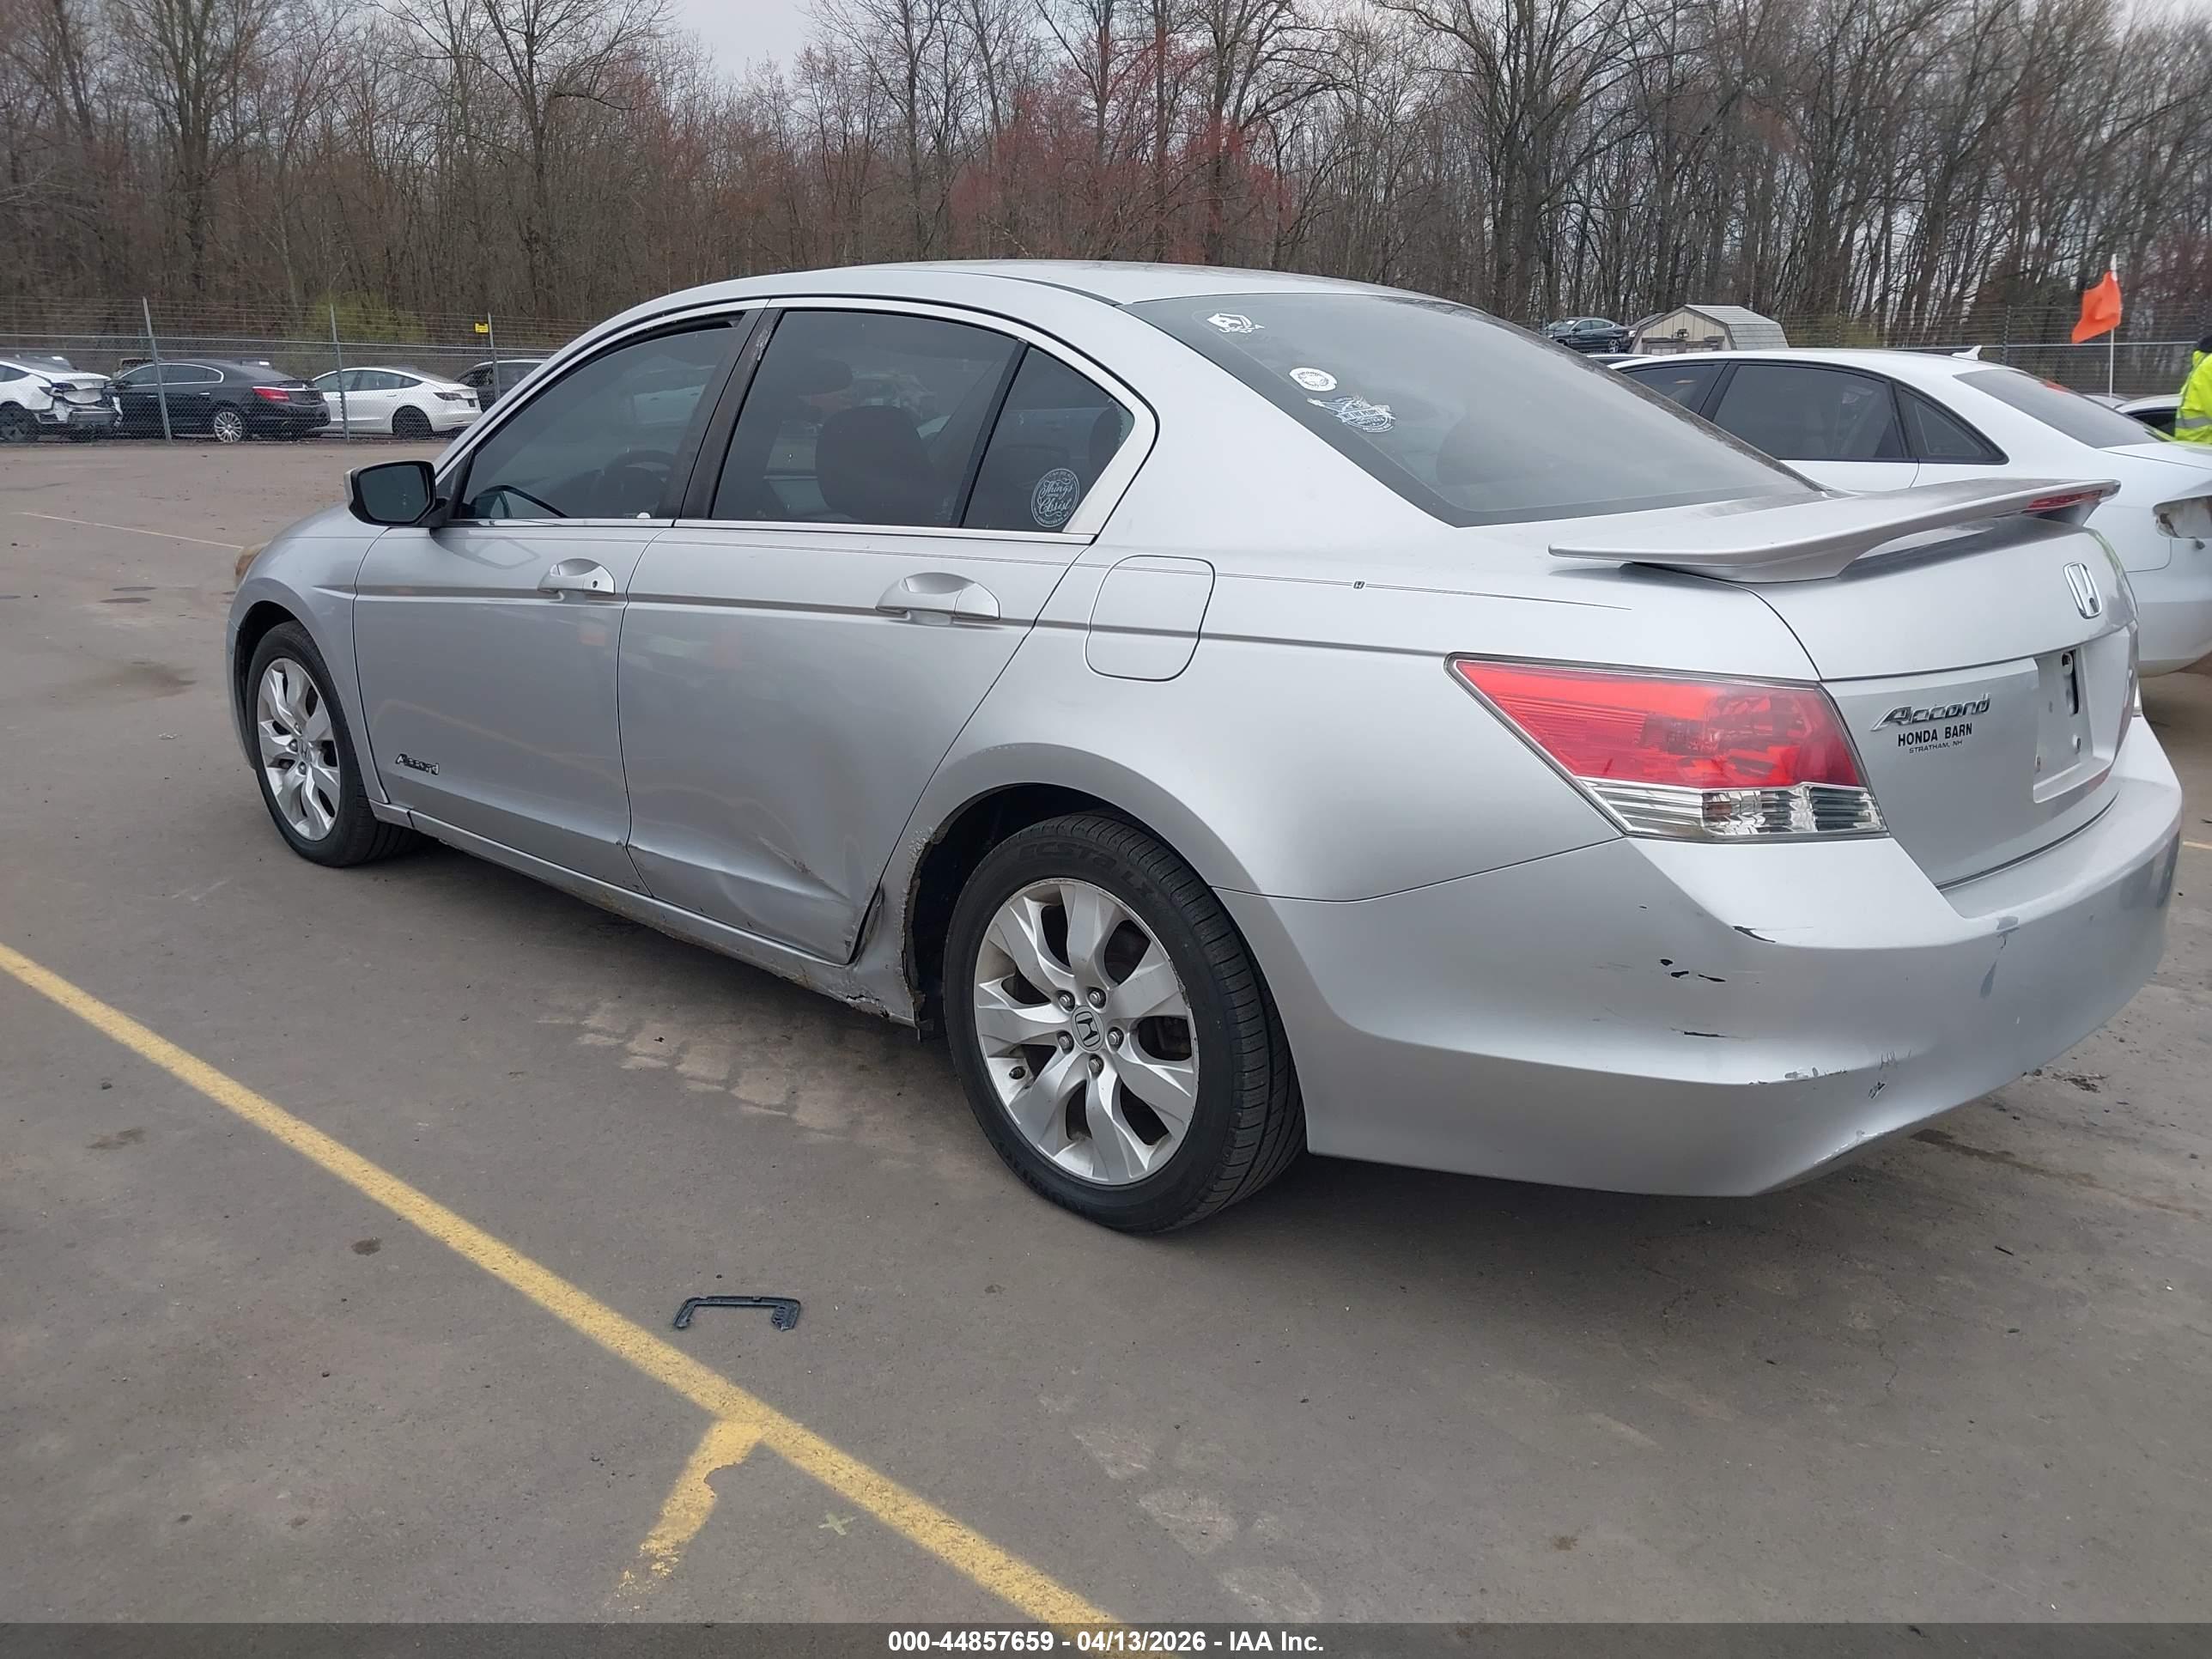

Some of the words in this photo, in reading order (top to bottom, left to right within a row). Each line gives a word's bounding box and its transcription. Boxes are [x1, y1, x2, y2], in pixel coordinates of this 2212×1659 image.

[1039, 480, 1073, 500] Things
[1037, 498, 1073, 515] Christ
[1870, 692, 1992, 732] Accord
[1897, 728, 1938, 747] HONDA
[1944, 722, 1972, 739] BARN
[1909, 742, 1950, 754] STRATHAM,
[395, 753, 440, 775] Accord
